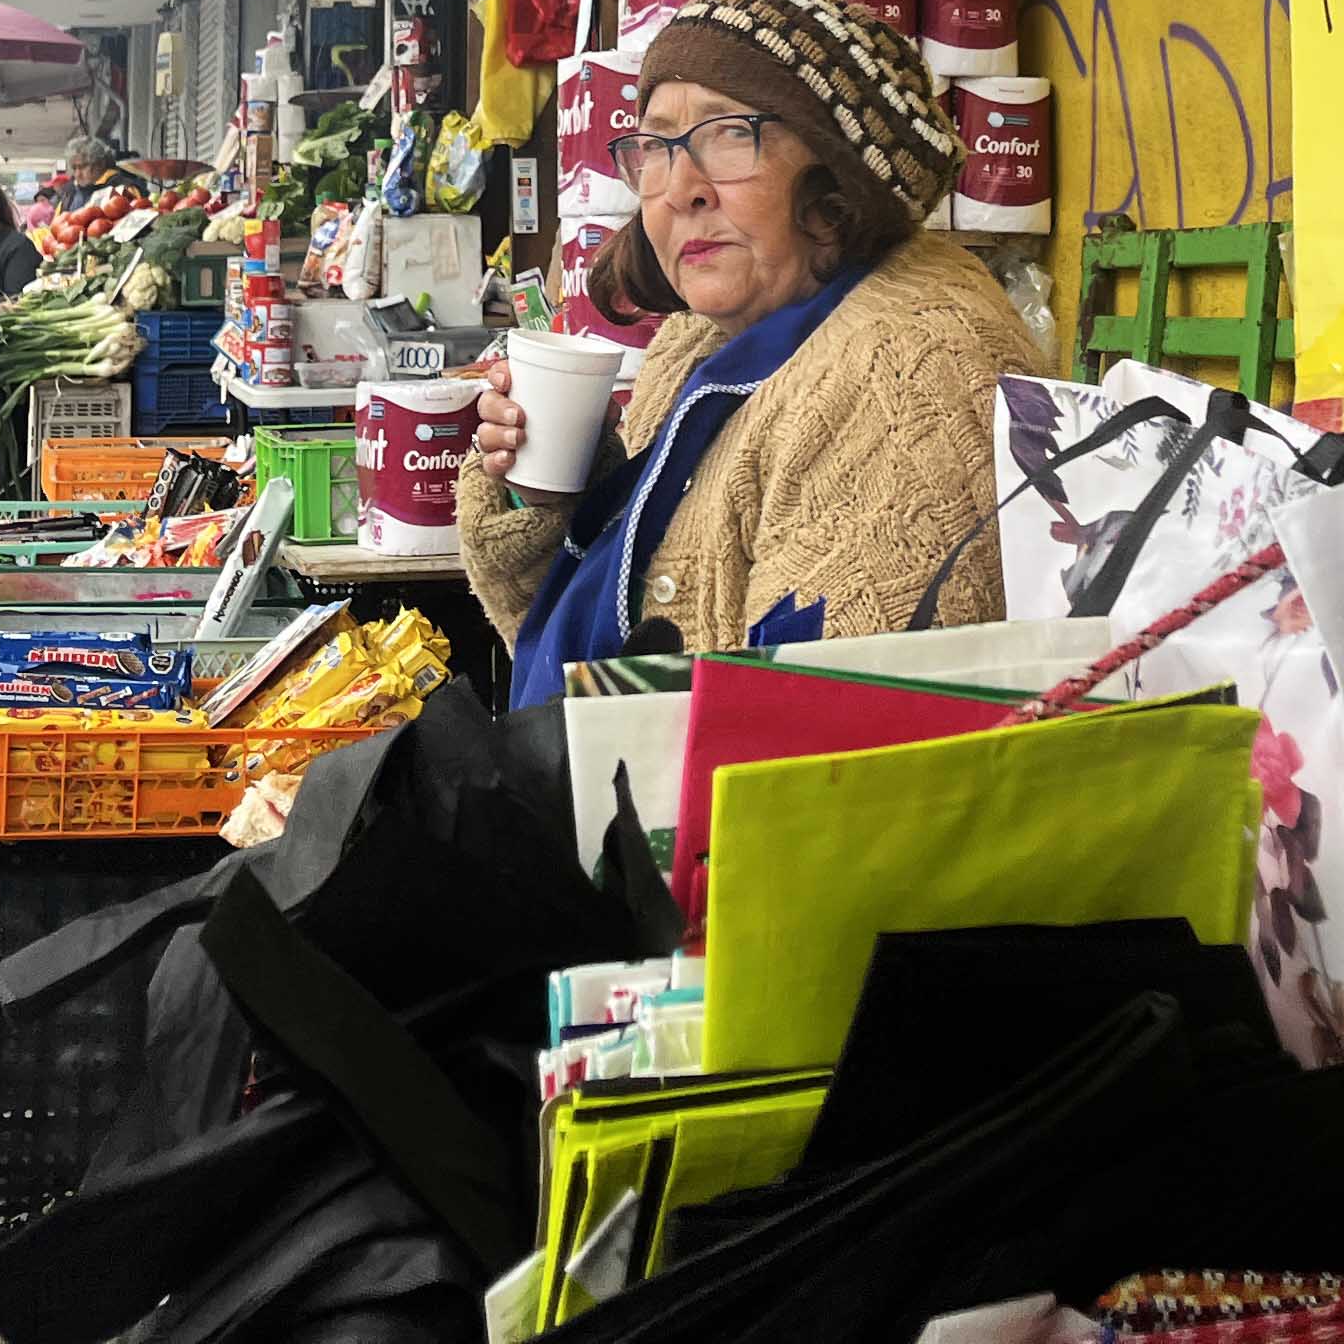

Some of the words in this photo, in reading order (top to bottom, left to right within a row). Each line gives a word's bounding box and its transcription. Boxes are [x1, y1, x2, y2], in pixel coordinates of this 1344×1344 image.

[884, 5, 901, 17] 30
[985, 9, 1001, 22] 30
[974, 135, 1041, 157] Confort
[1015, 165, 1033, 178] 30
[396, 346, 440, 369] 1000
[402, 448, 471, 472] Confor
